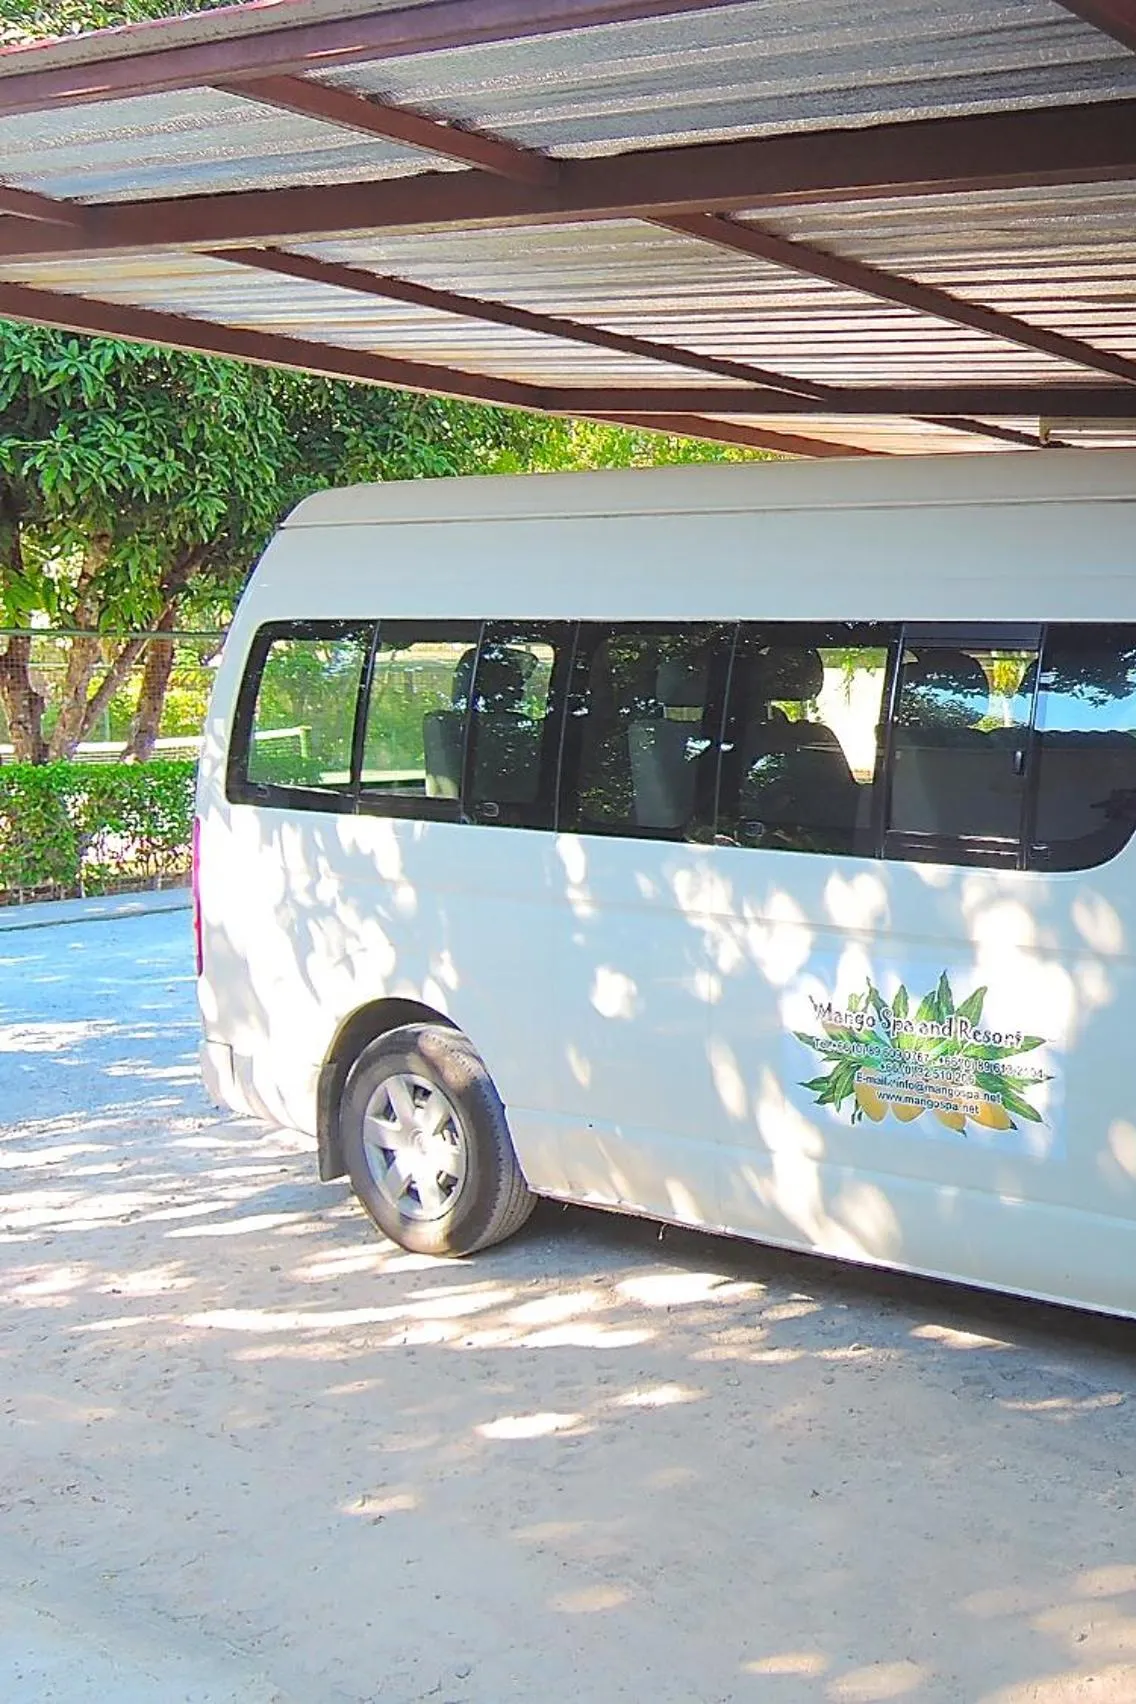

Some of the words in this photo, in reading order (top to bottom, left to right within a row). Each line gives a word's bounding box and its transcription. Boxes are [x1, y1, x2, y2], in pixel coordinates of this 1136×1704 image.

[808, 995, 877, 1033] Mango
[881, 1006, 914, 1038] Spa
[919, 1016, 953, 1038] and
[959, 1019, 1022, 1048] Resort
